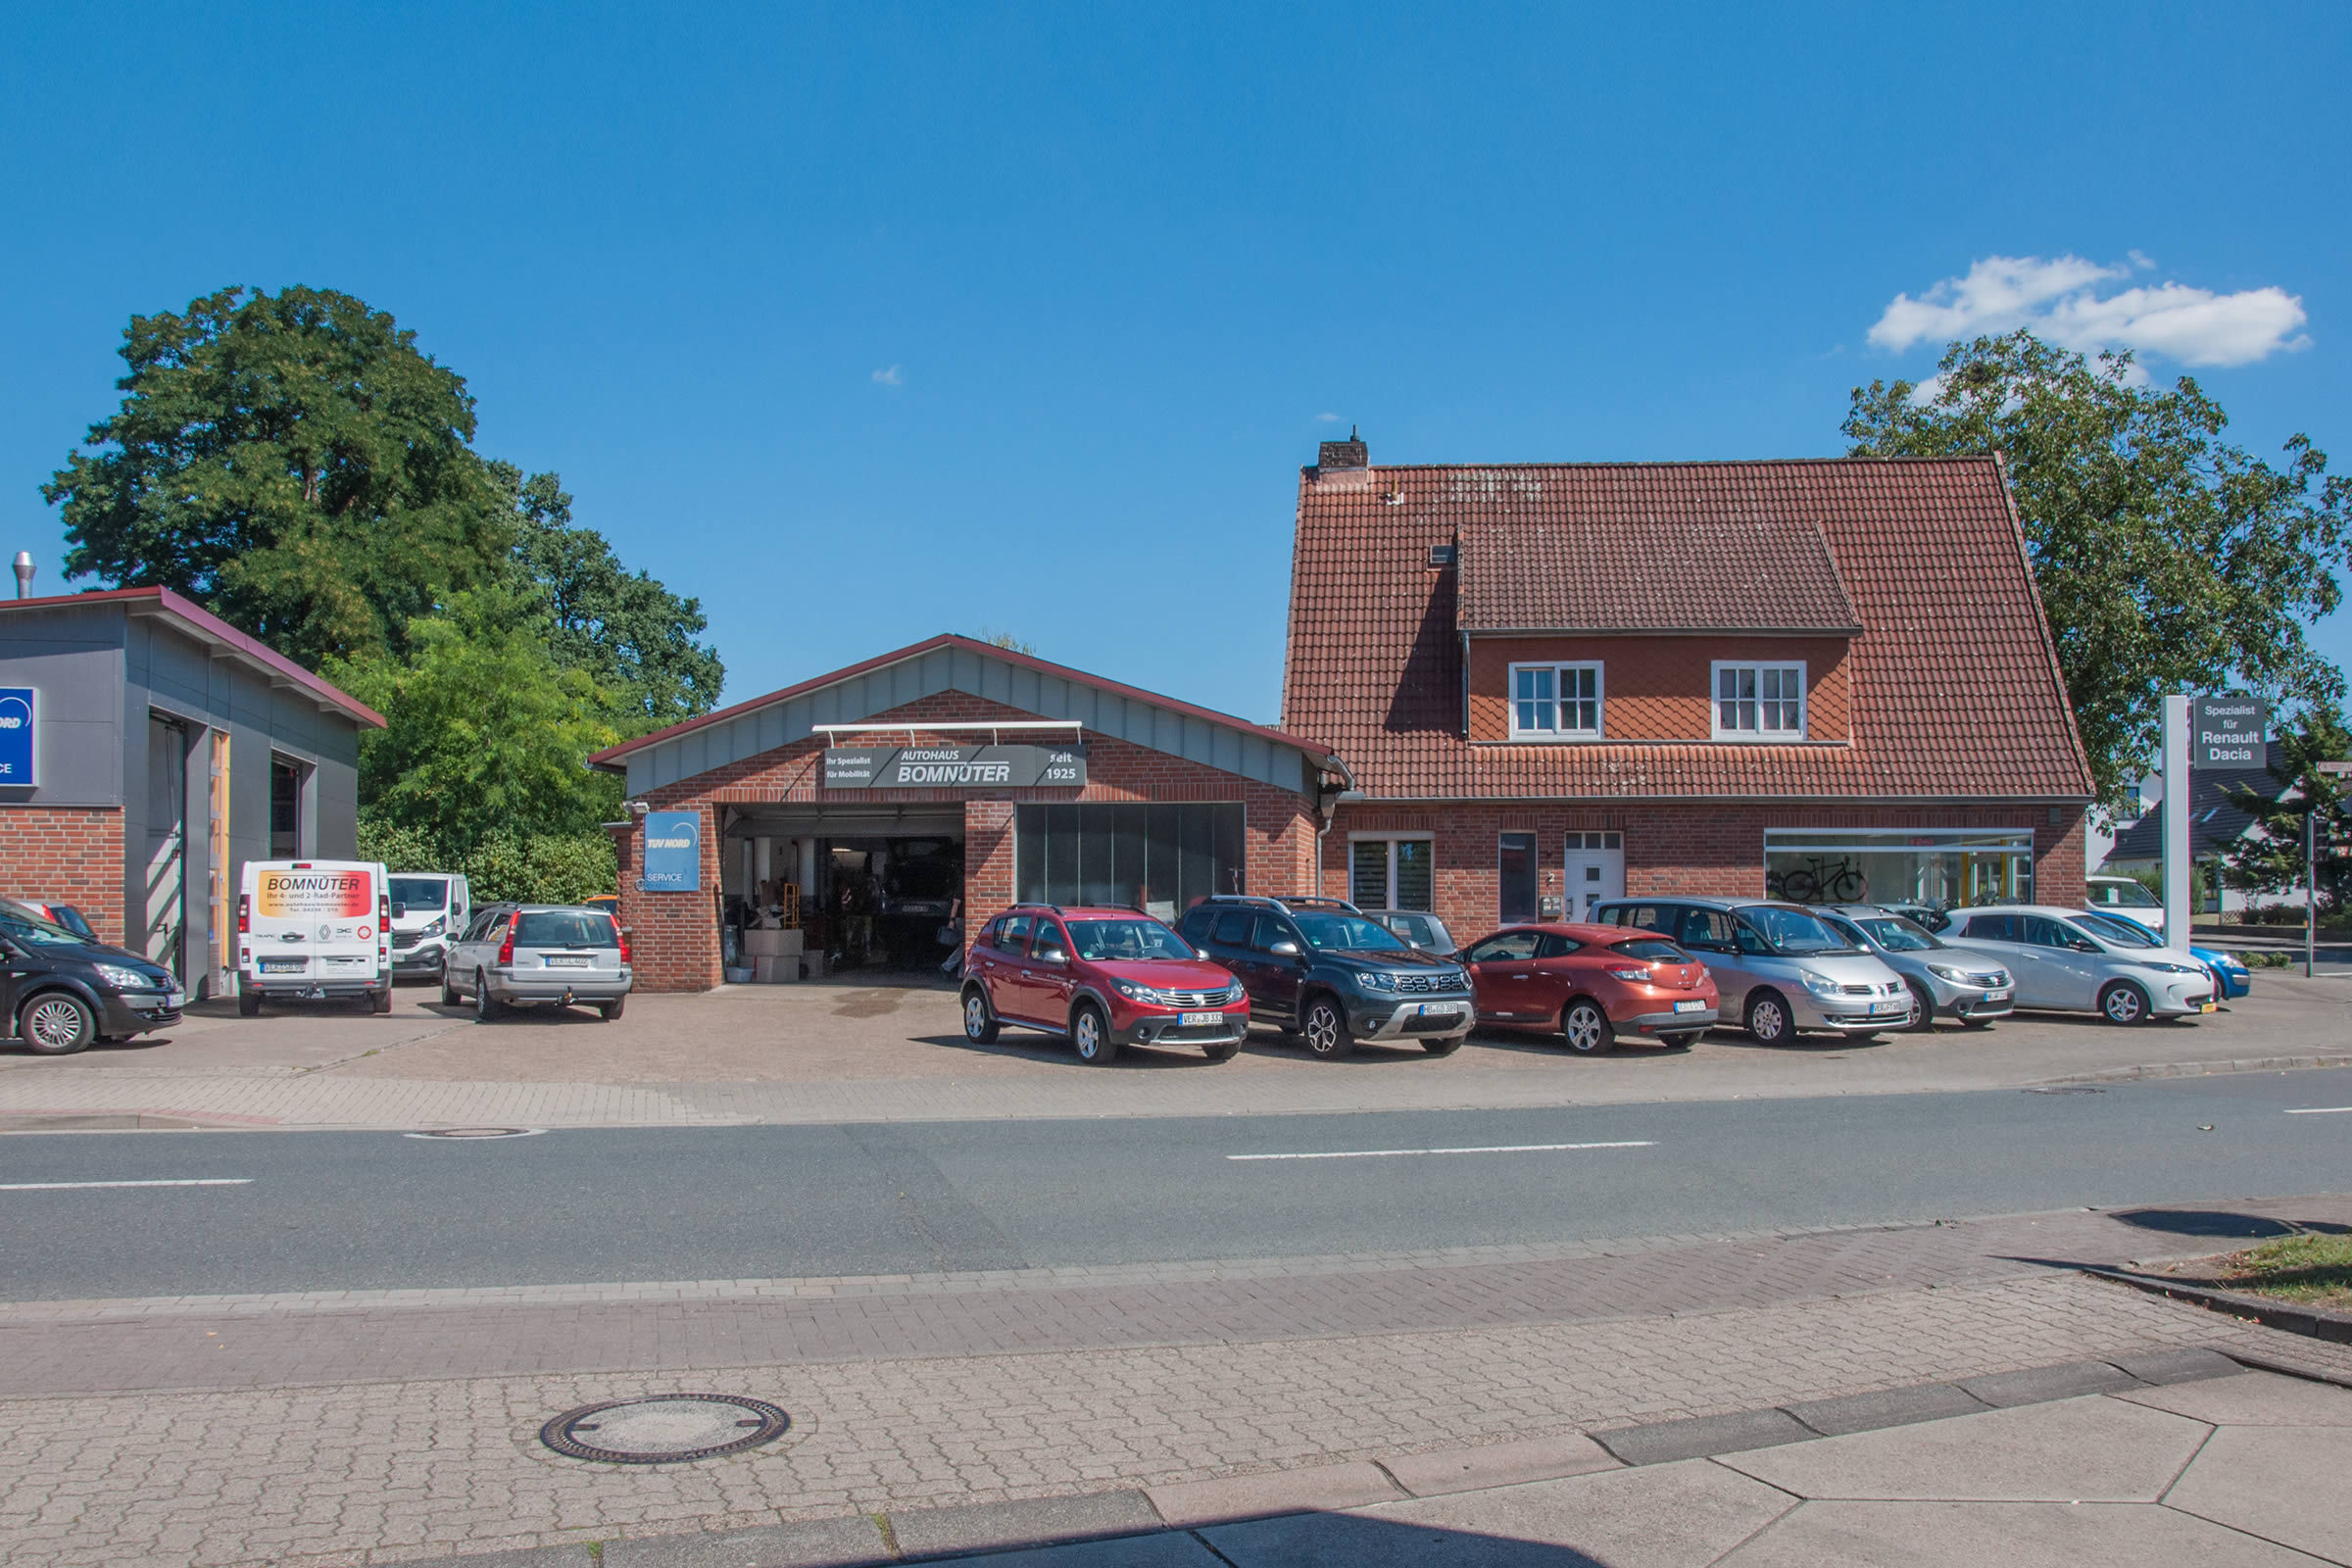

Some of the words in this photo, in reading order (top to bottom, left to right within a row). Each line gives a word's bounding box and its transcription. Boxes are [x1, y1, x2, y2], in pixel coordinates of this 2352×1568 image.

[2204, 705, 2256, 717] Spezialist
[2223, 719, 2238, 729] für
[2201, 731, 2259, 744] Renault
[901, 750, 959, 760] AUTOHAUS
[1050, 752, 1072, 763] seit
[2208, 748, 2252, 760] Dacia
[837, 757, 871, 765] Spezialist
[897, 762, 1010, 782] BOMNÜTER
[1046, 767, 1076, 779] 1925
[663, 838, 691, 849] NORD
[647, 872, 683, 882] SERVICE
[267, 875, 361, 891] BOMNÜTER
[1183, 1013, 1197, 1023] VER
